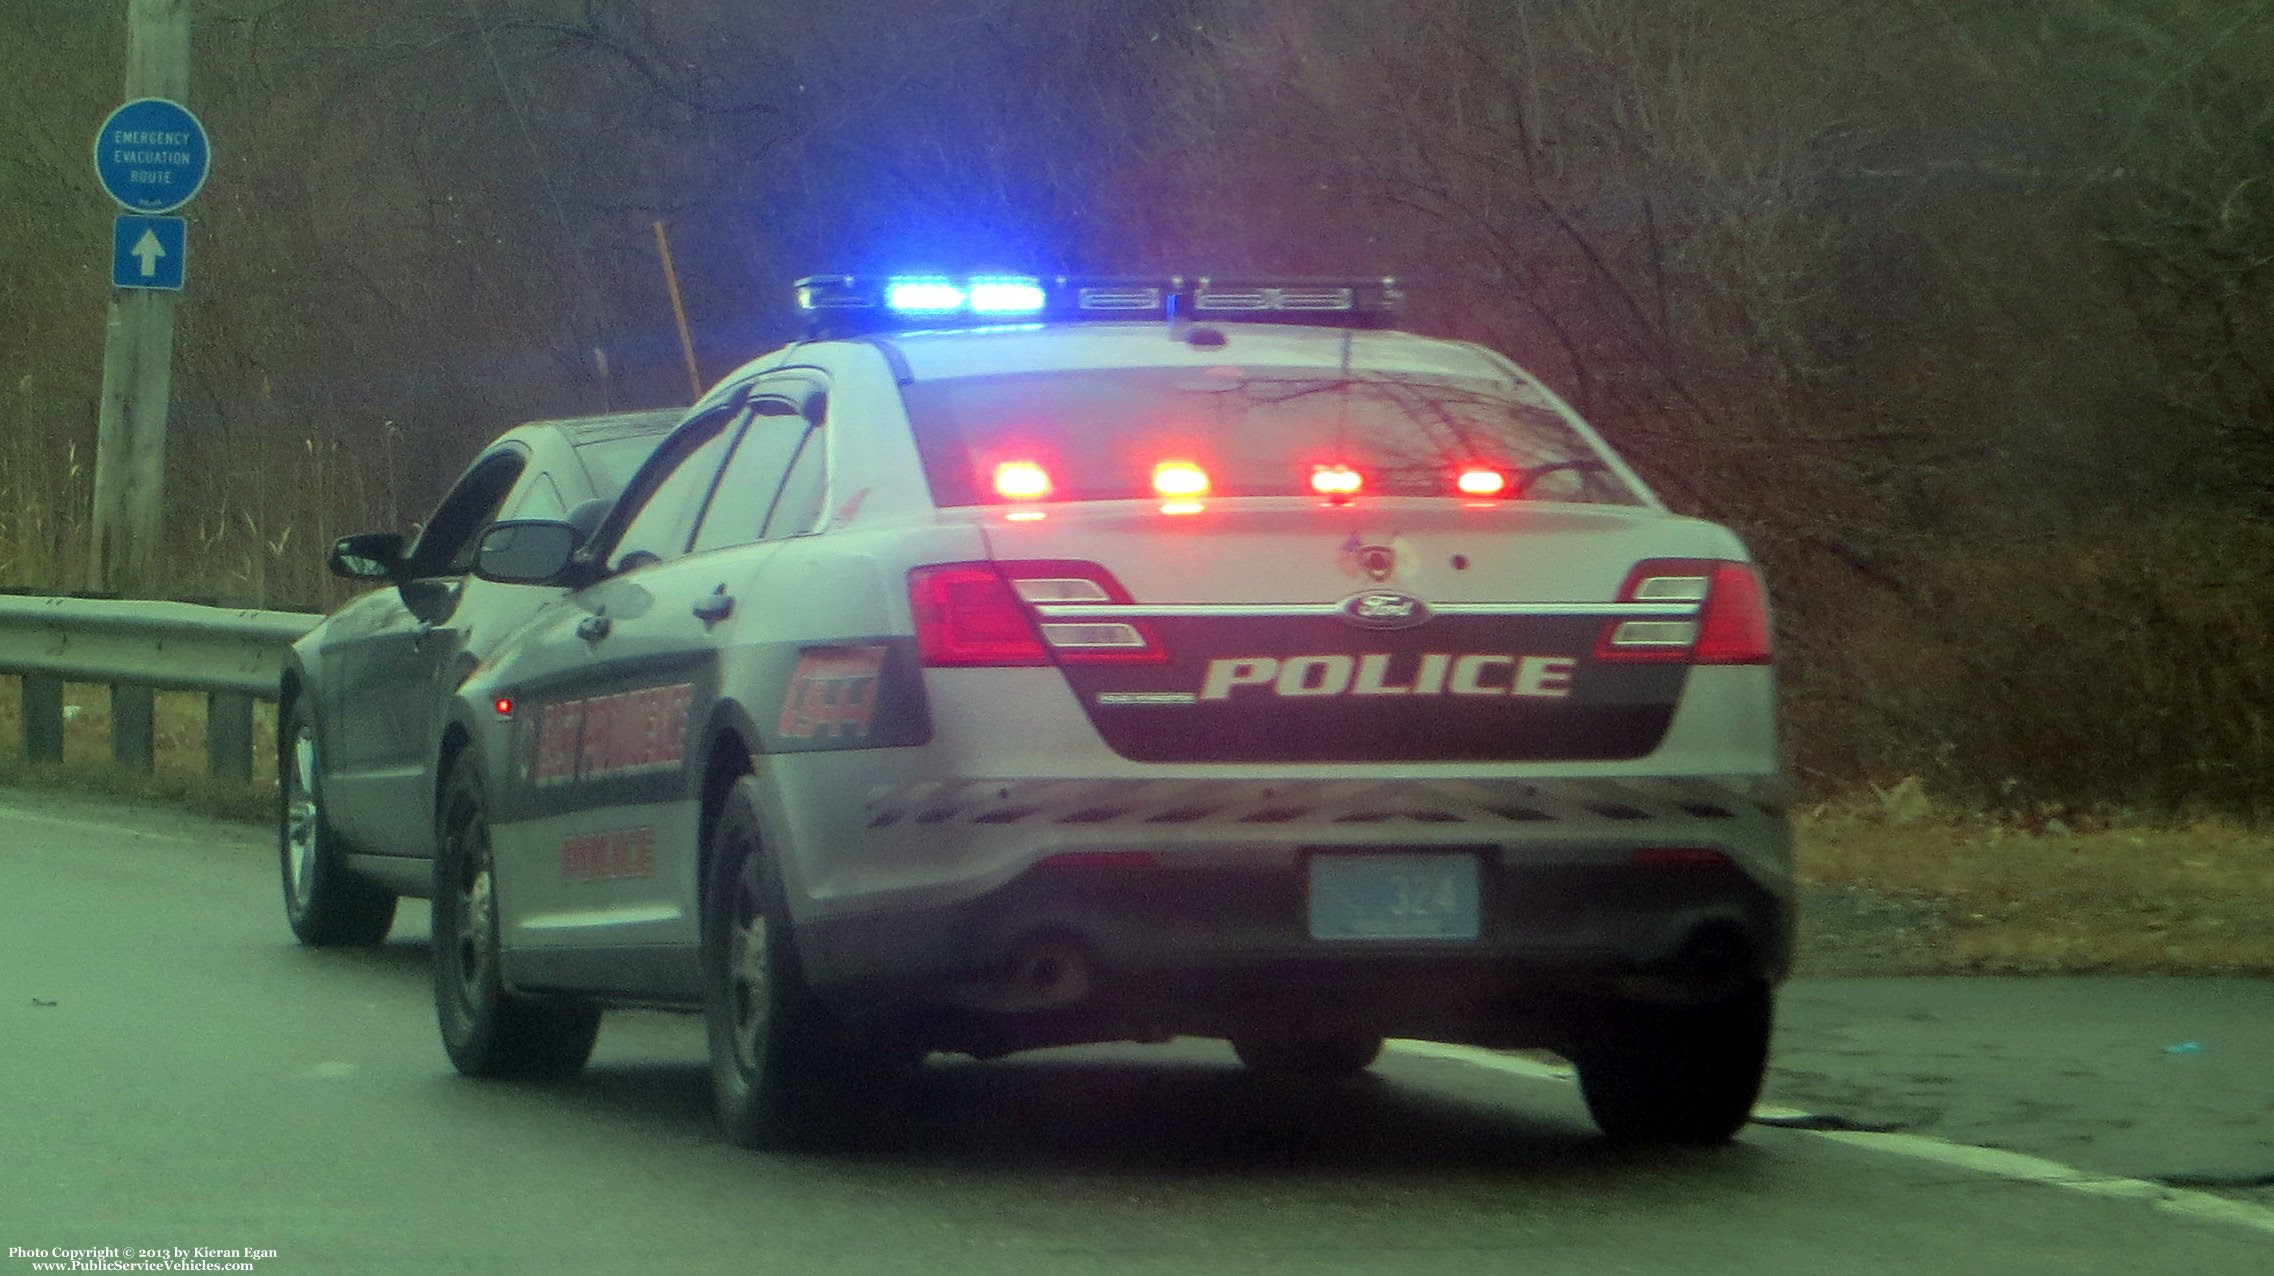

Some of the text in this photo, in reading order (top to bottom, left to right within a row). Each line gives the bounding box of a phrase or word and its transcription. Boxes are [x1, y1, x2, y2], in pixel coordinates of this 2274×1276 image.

[115, 131, 190, 145] EMERGENCY
[114, 150, 191, 164] EVACUATION
[131, 170, 171, 184] ROUTE
[1200, 654, 1576, 700] POLICE
[1389, 875, 1456, 916] 324
